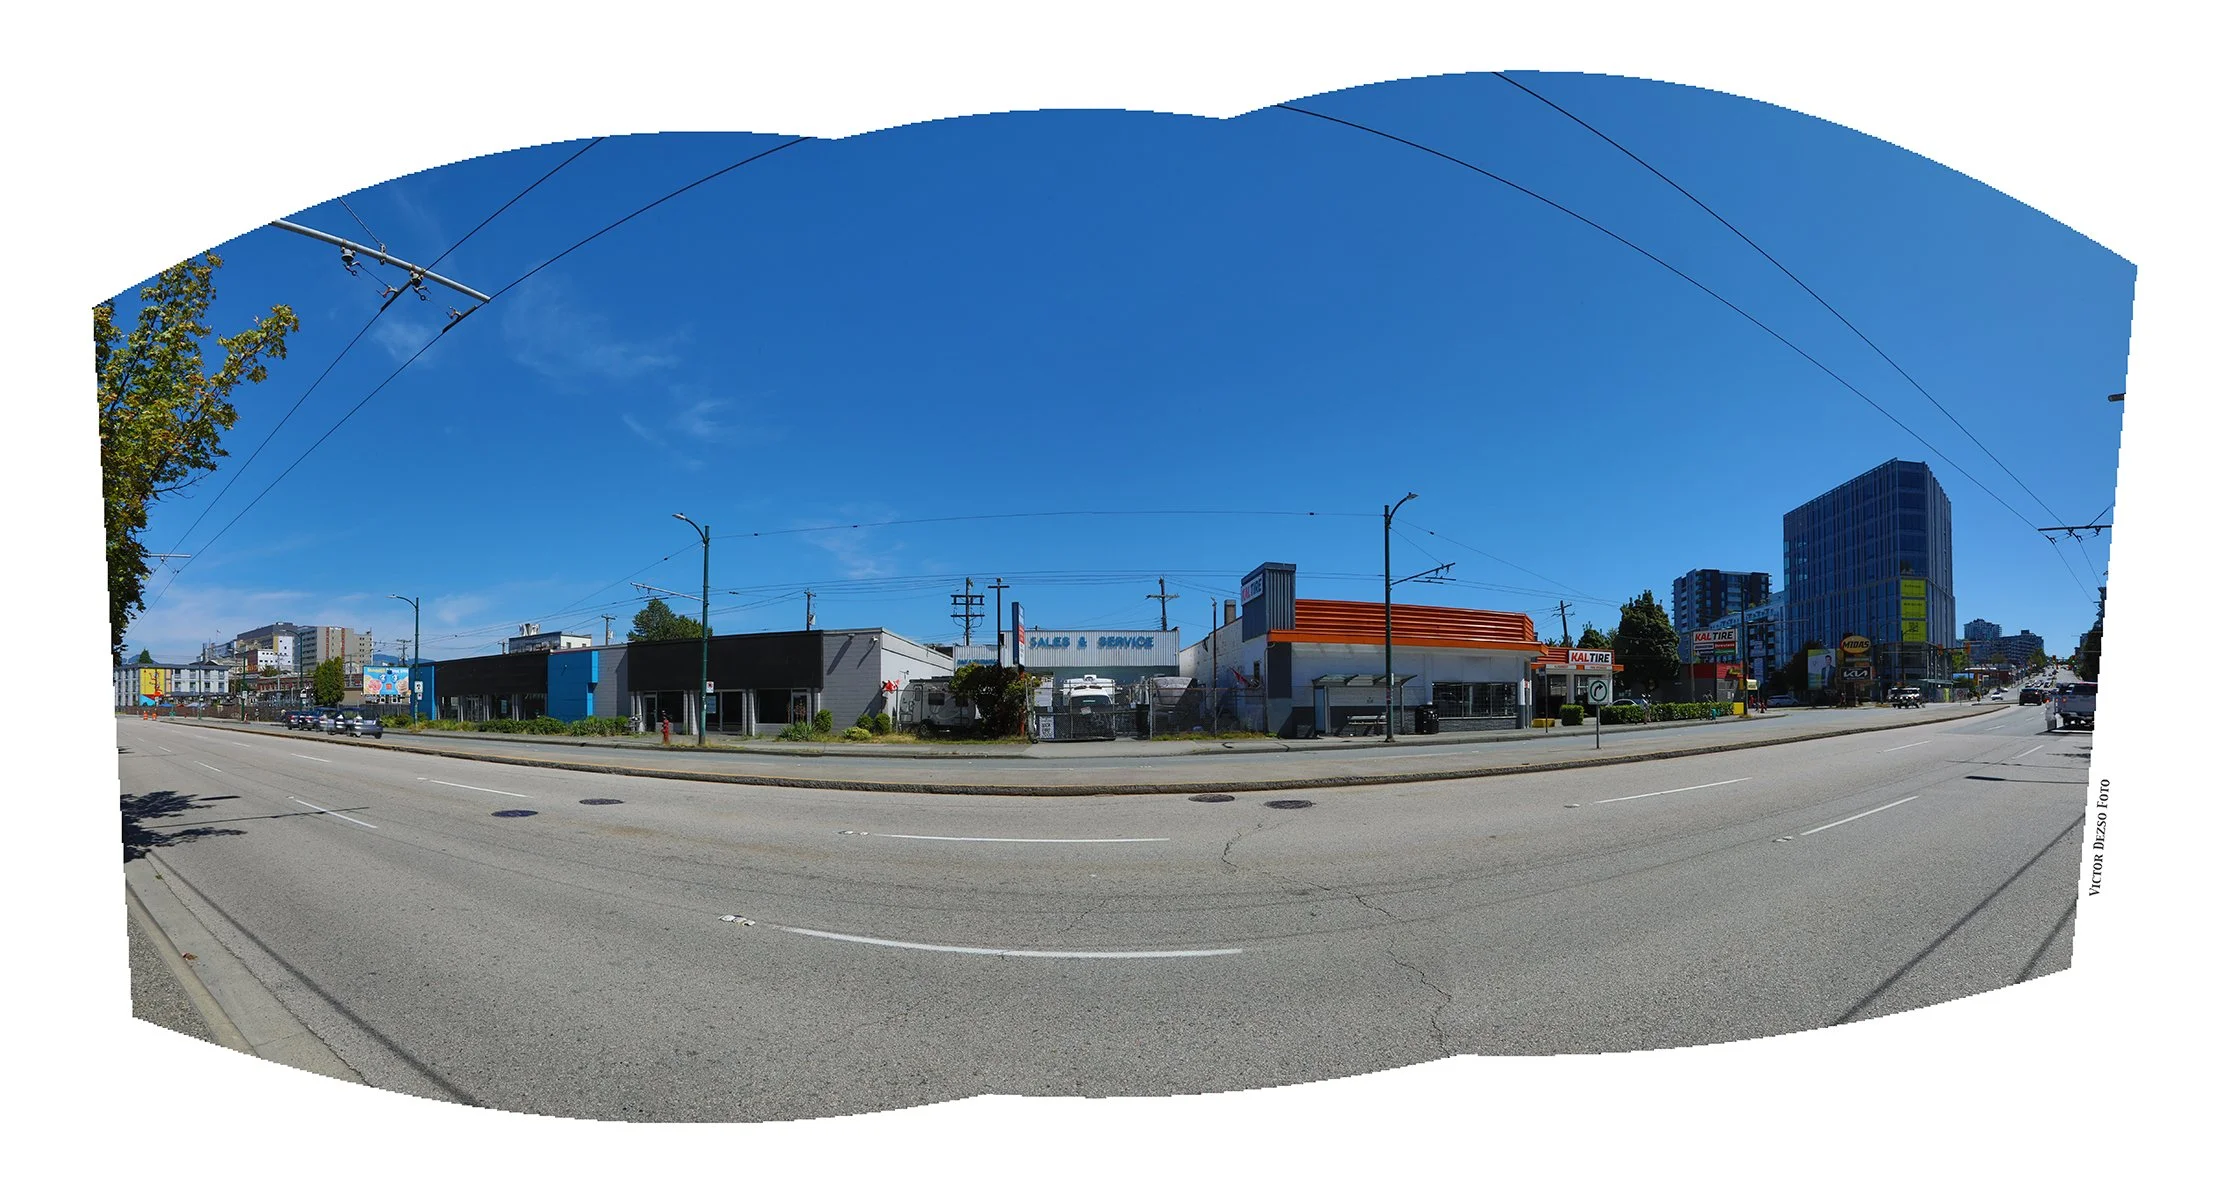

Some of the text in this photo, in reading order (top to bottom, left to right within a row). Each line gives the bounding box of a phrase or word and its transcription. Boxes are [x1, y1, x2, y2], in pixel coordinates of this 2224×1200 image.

[1028, 636, 1155, 650] SALES & SERVICE
[1842, 640, 1870, 649] MIDAS
